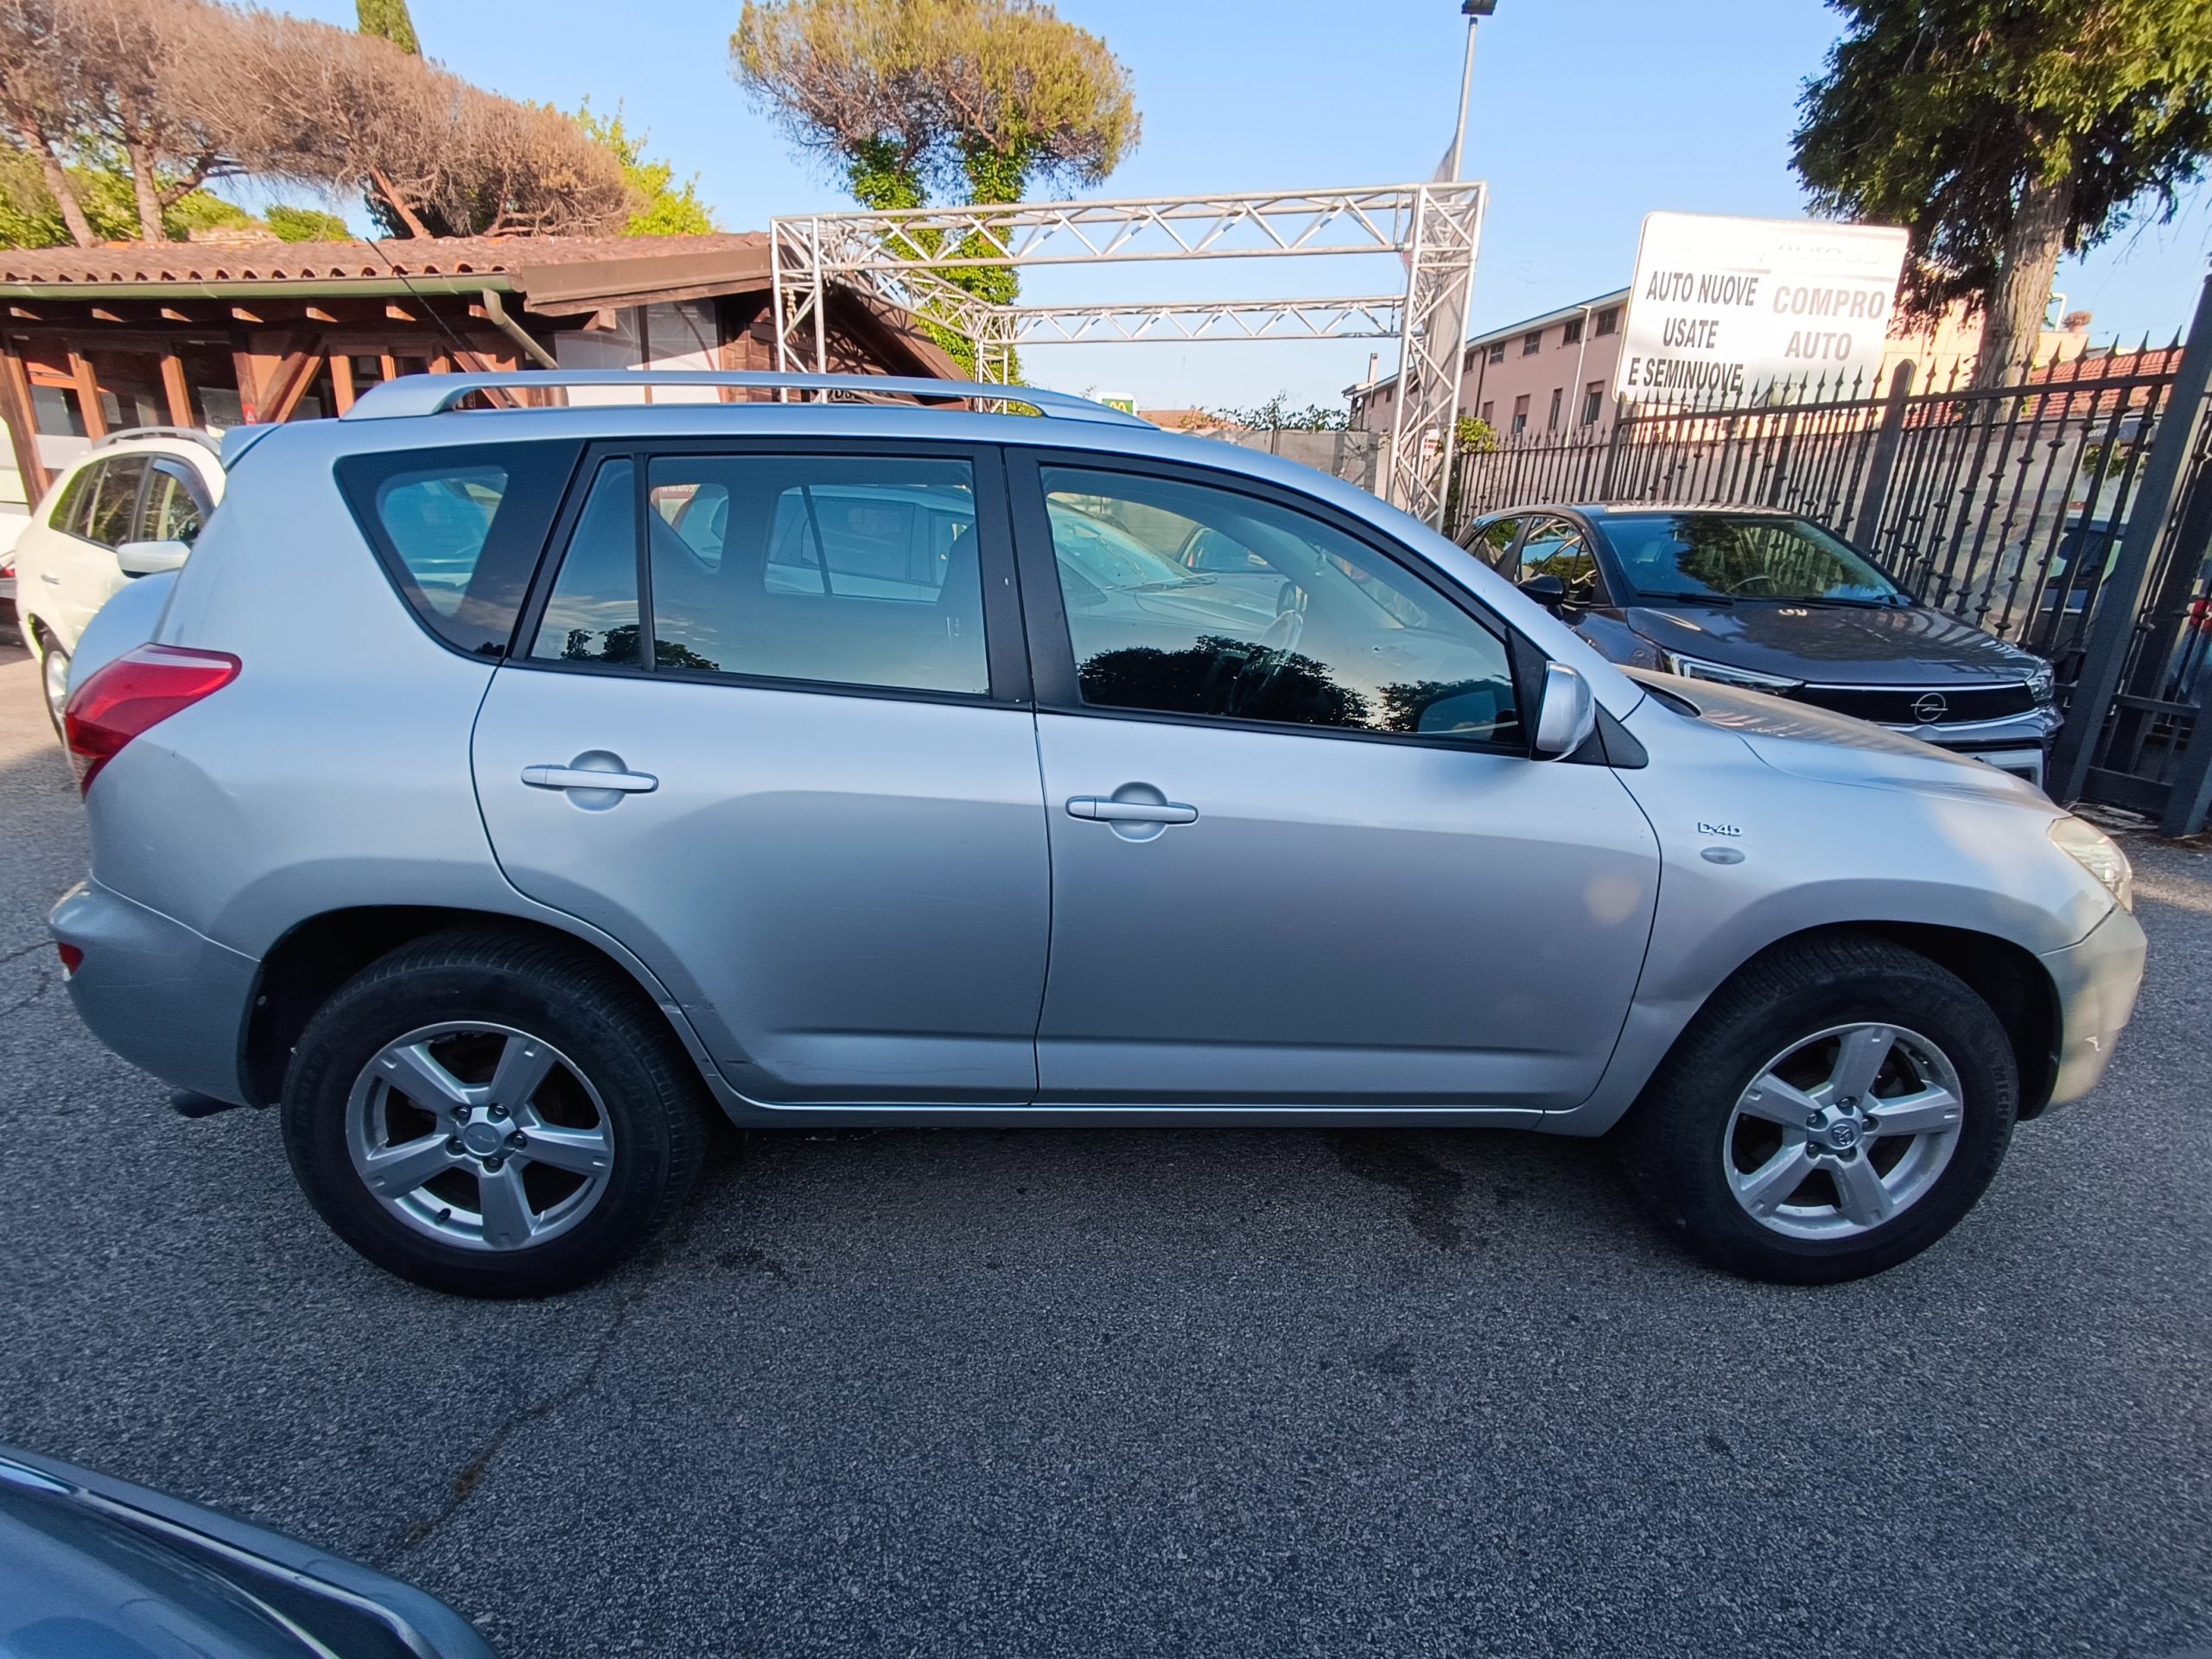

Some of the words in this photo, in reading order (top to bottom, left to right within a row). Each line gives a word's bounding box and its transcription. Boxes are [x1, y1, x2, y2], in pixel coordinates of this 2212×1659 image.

[1645, 270, 1694, 302] AUTO
[1697, 274, 1759, 306] NUOVE
[1773, 285, 1886, 319] COMPRO
[1663, 317, 1719, 348] USATE
[1784, 330, 1853, 361] AUTO
[1628, 357, 1641, 385] E
[1643, 358, 1744, 391] SEMINUOVE
